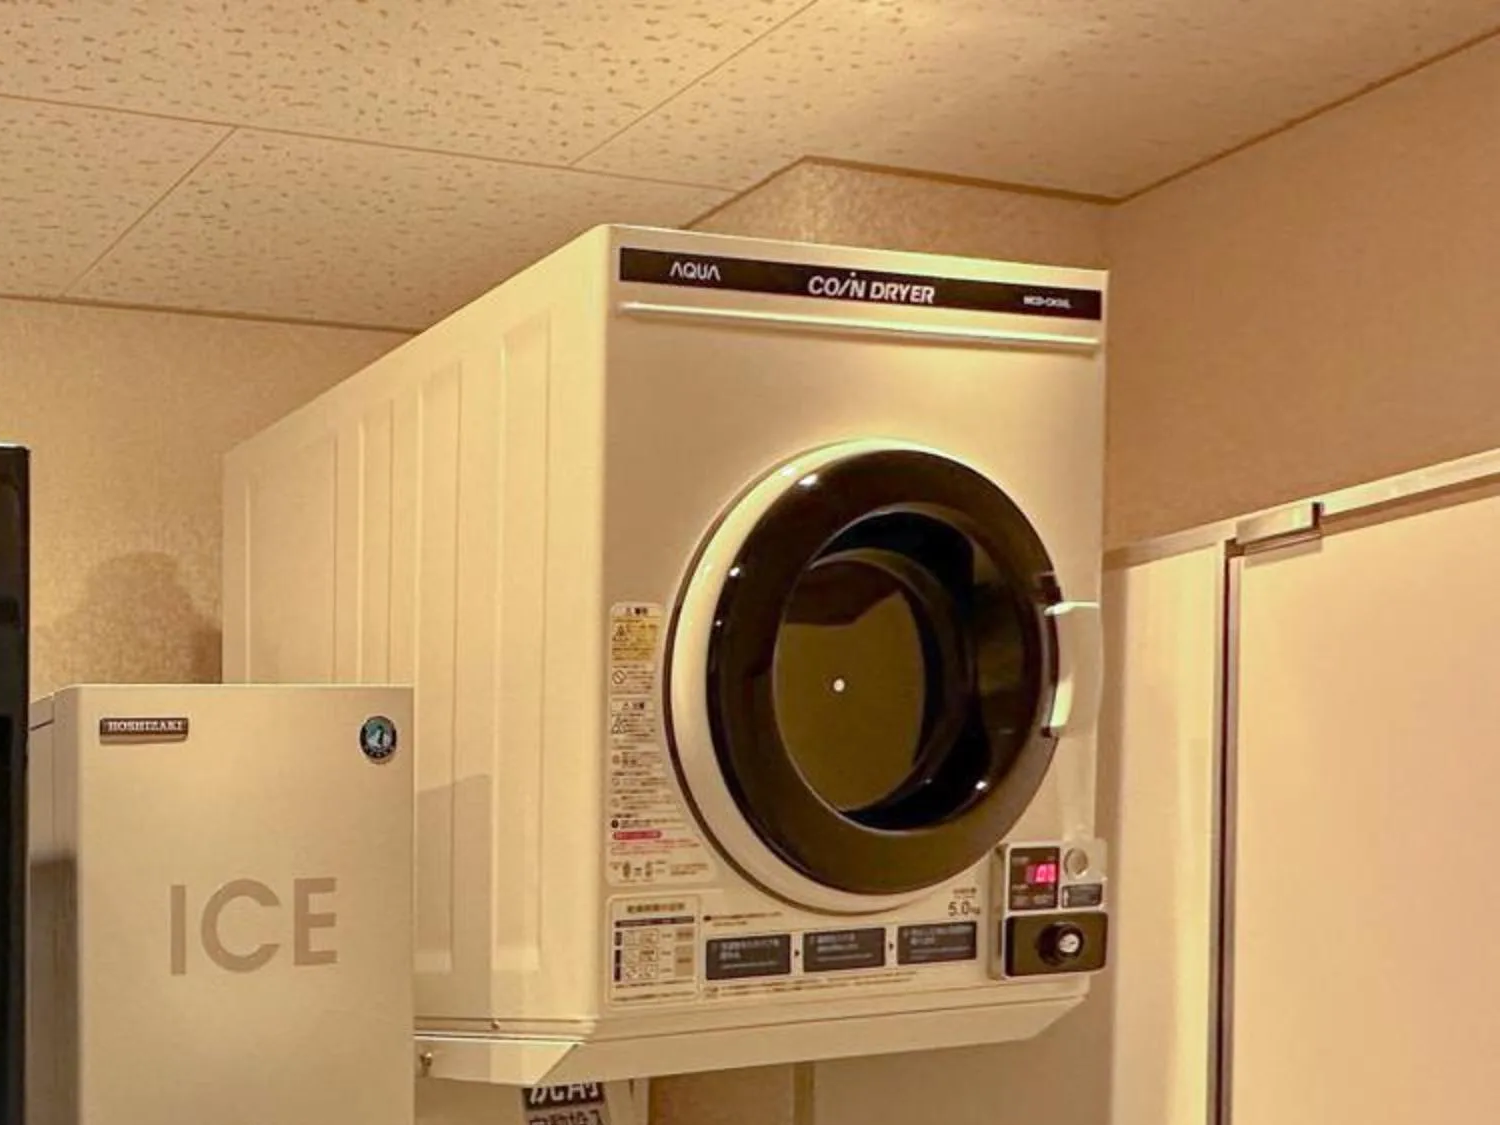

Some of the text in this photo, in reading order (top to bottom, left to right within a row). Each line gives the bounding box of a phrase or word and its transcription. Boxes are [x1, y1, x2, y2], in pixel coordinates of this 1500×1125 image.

[670, 259, 721, 282] AQUA
[807, 271, 936, 305] COIN DRYER
[107, 719, 184, 732] HOSHIZAKI
[169, 876, 338, 977] ICE
